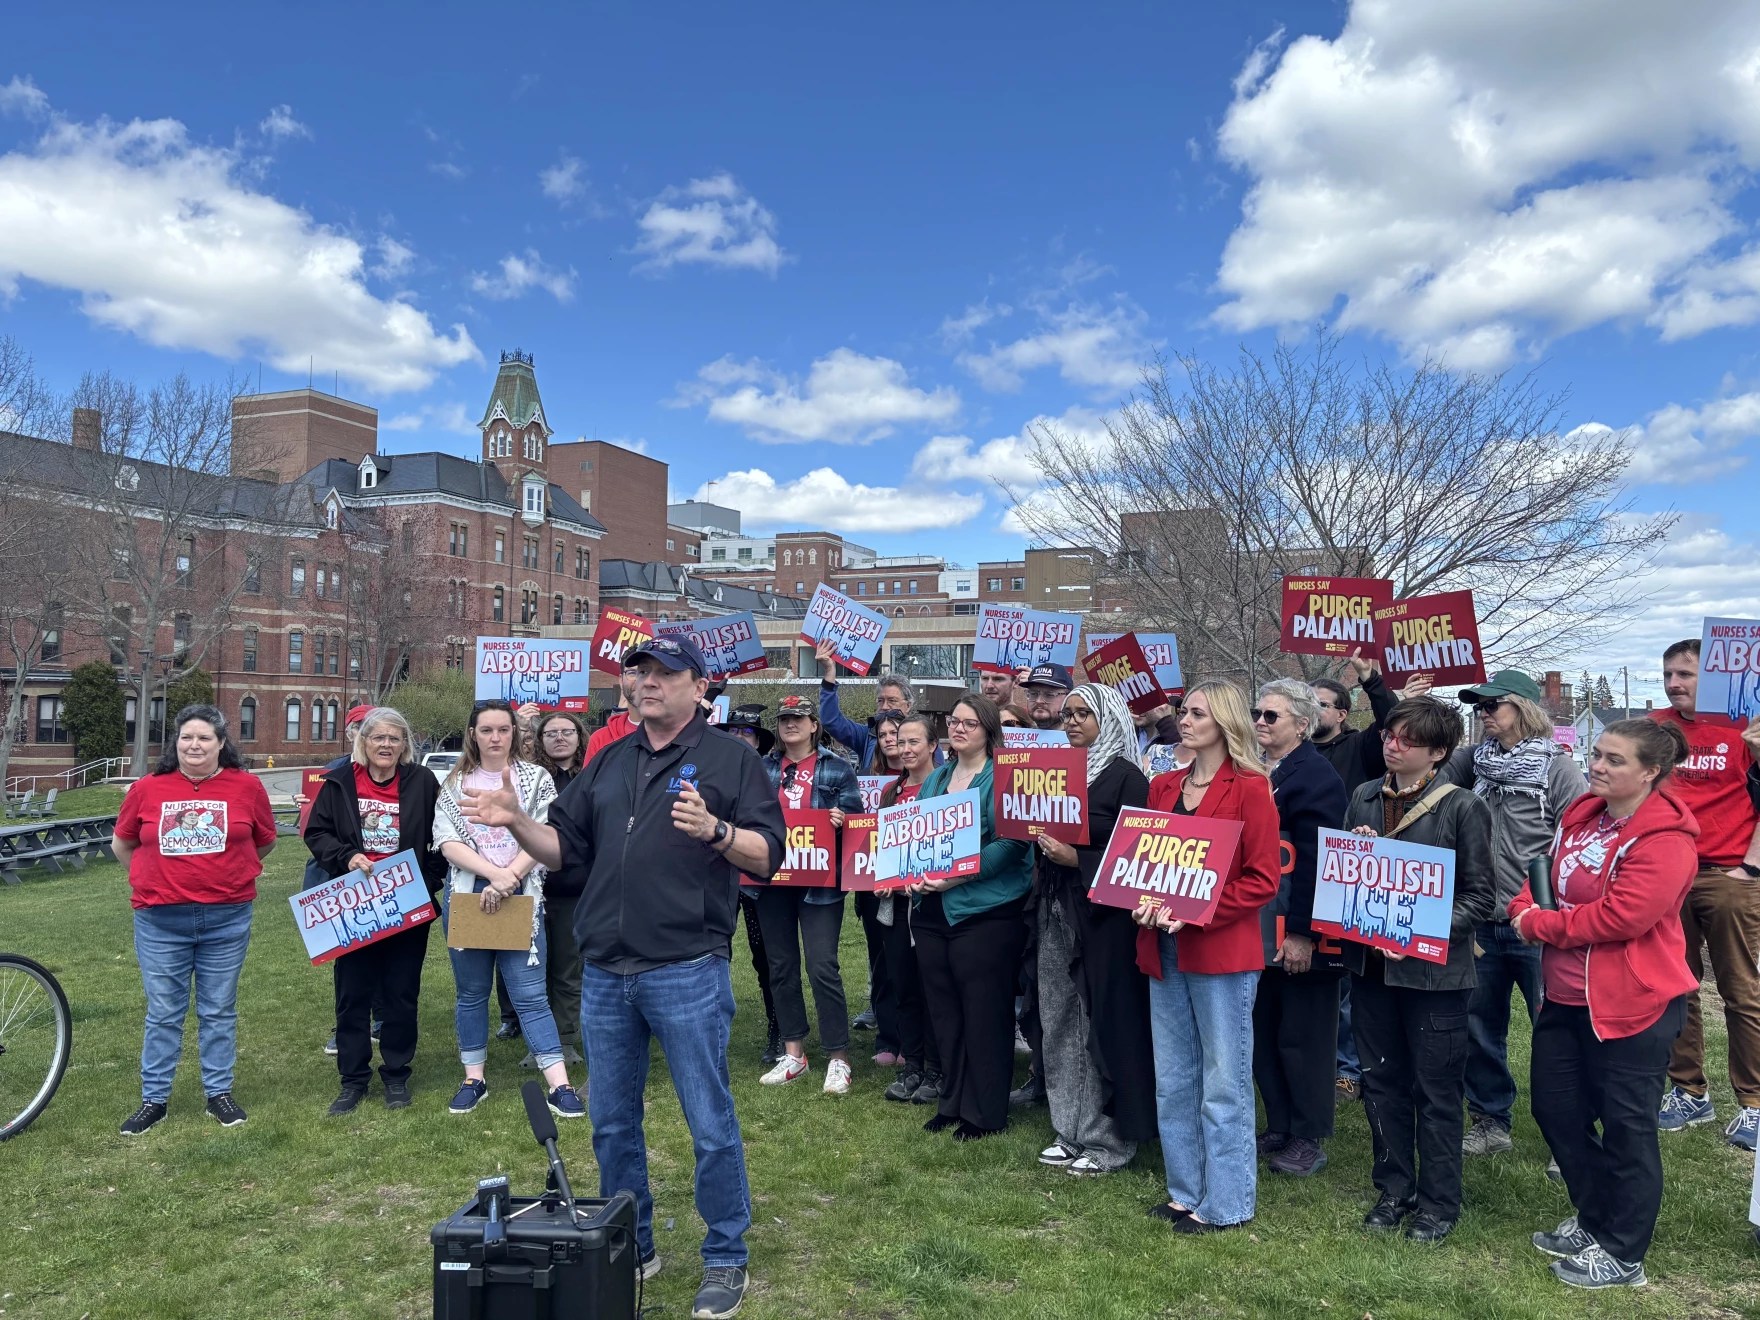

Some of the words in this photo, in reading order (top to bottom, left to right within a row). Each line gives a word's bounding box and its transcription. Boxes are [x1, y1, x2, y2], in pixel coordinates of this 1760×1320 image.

[819, 589, 837, 601] NURSES
[836, 596, 847, 606] SAY
[1288, 581, 1315, 590] NURSES
[1317, 581, 1330, 590] SAY
[606, 611, 631, 625] NURSES
[630, 616, 643, 628] SAY
[811, 596, 882, 642] ABOLISH
[985, 609, 1009, 619] NURSES
[1011, 611, 1024, 620] SAY
[1309, 594, 1372, 620] PURGE
[1374, 607, 1395, 621] NURSES
[1396, 603, 1408, 616] SAY
[657, 626, 682, 634] NURSES
[683, 624, 695, 632] SAY
[687, 620, 752, 651] OLISH
[980, 618, 1074, 644] ABOLISH
[1293, 614, 1375, 643] PALANTI
[1392, 614, 1454, 646] PURGE
[1711, 625, 1747, 638] NURSES
[1749, 626, 1760, 638] SA
[483, 642, 510, 650] NURSES
[512, 642, 526, 650] SAY
[996, 638, 1054, 671] ICE
[1384, 638, 1476, 672] PALANTIR
[481, 650, 582, 673] ABOLISH
[1097, 654, 1136, 687] PURGE
[501, 669, 561, 707] ICE
[1027, 733, 1039, 742] SAY
[997, 753, 1018, 764] NURSES
[1019, 752, 1031, 763] SAY
[867, 780, 879, 788] SAY
[1013, 768, 1067, 796] PURGE
[164, 802, 205, 811] NURSES
[206, 802, 225, 810] FOR
[358, 800, 387, 811] URSES
[884, 809, 908, 824] NURSES
[909, 805, 921, 816] SAY
[1002, 793, 1082, 824] PALANTIR
[848, 818, 875, 829] NURSES
[882, 801, 973, 849] ABOLISH
[1123, 816, 1152, 829] NURSES
[1152, 818, 1170, 829] SAY
[161, 835, 225, 848] DEMOCRACY
[785, 826, 815, 849] RGE
[1325, 836, 1356, 851] NURSES
[1358, 841, 1374, 853] SAY
[899, 831, 955, 879] ICE
[1135, 833, 1210, 869] PURGE
[1110, 857, 1218, 901] PALANTIR
[1322, 850, 1444, 898] ABOLISH
[298, 888, 330, 907] NURSES
[332, 879, 346, 892] SAY
[304, 861, 414, 929] ABOLISH
[330, 888, 405, 948] ICE
[1341, 882, 1417, 948] ICE
